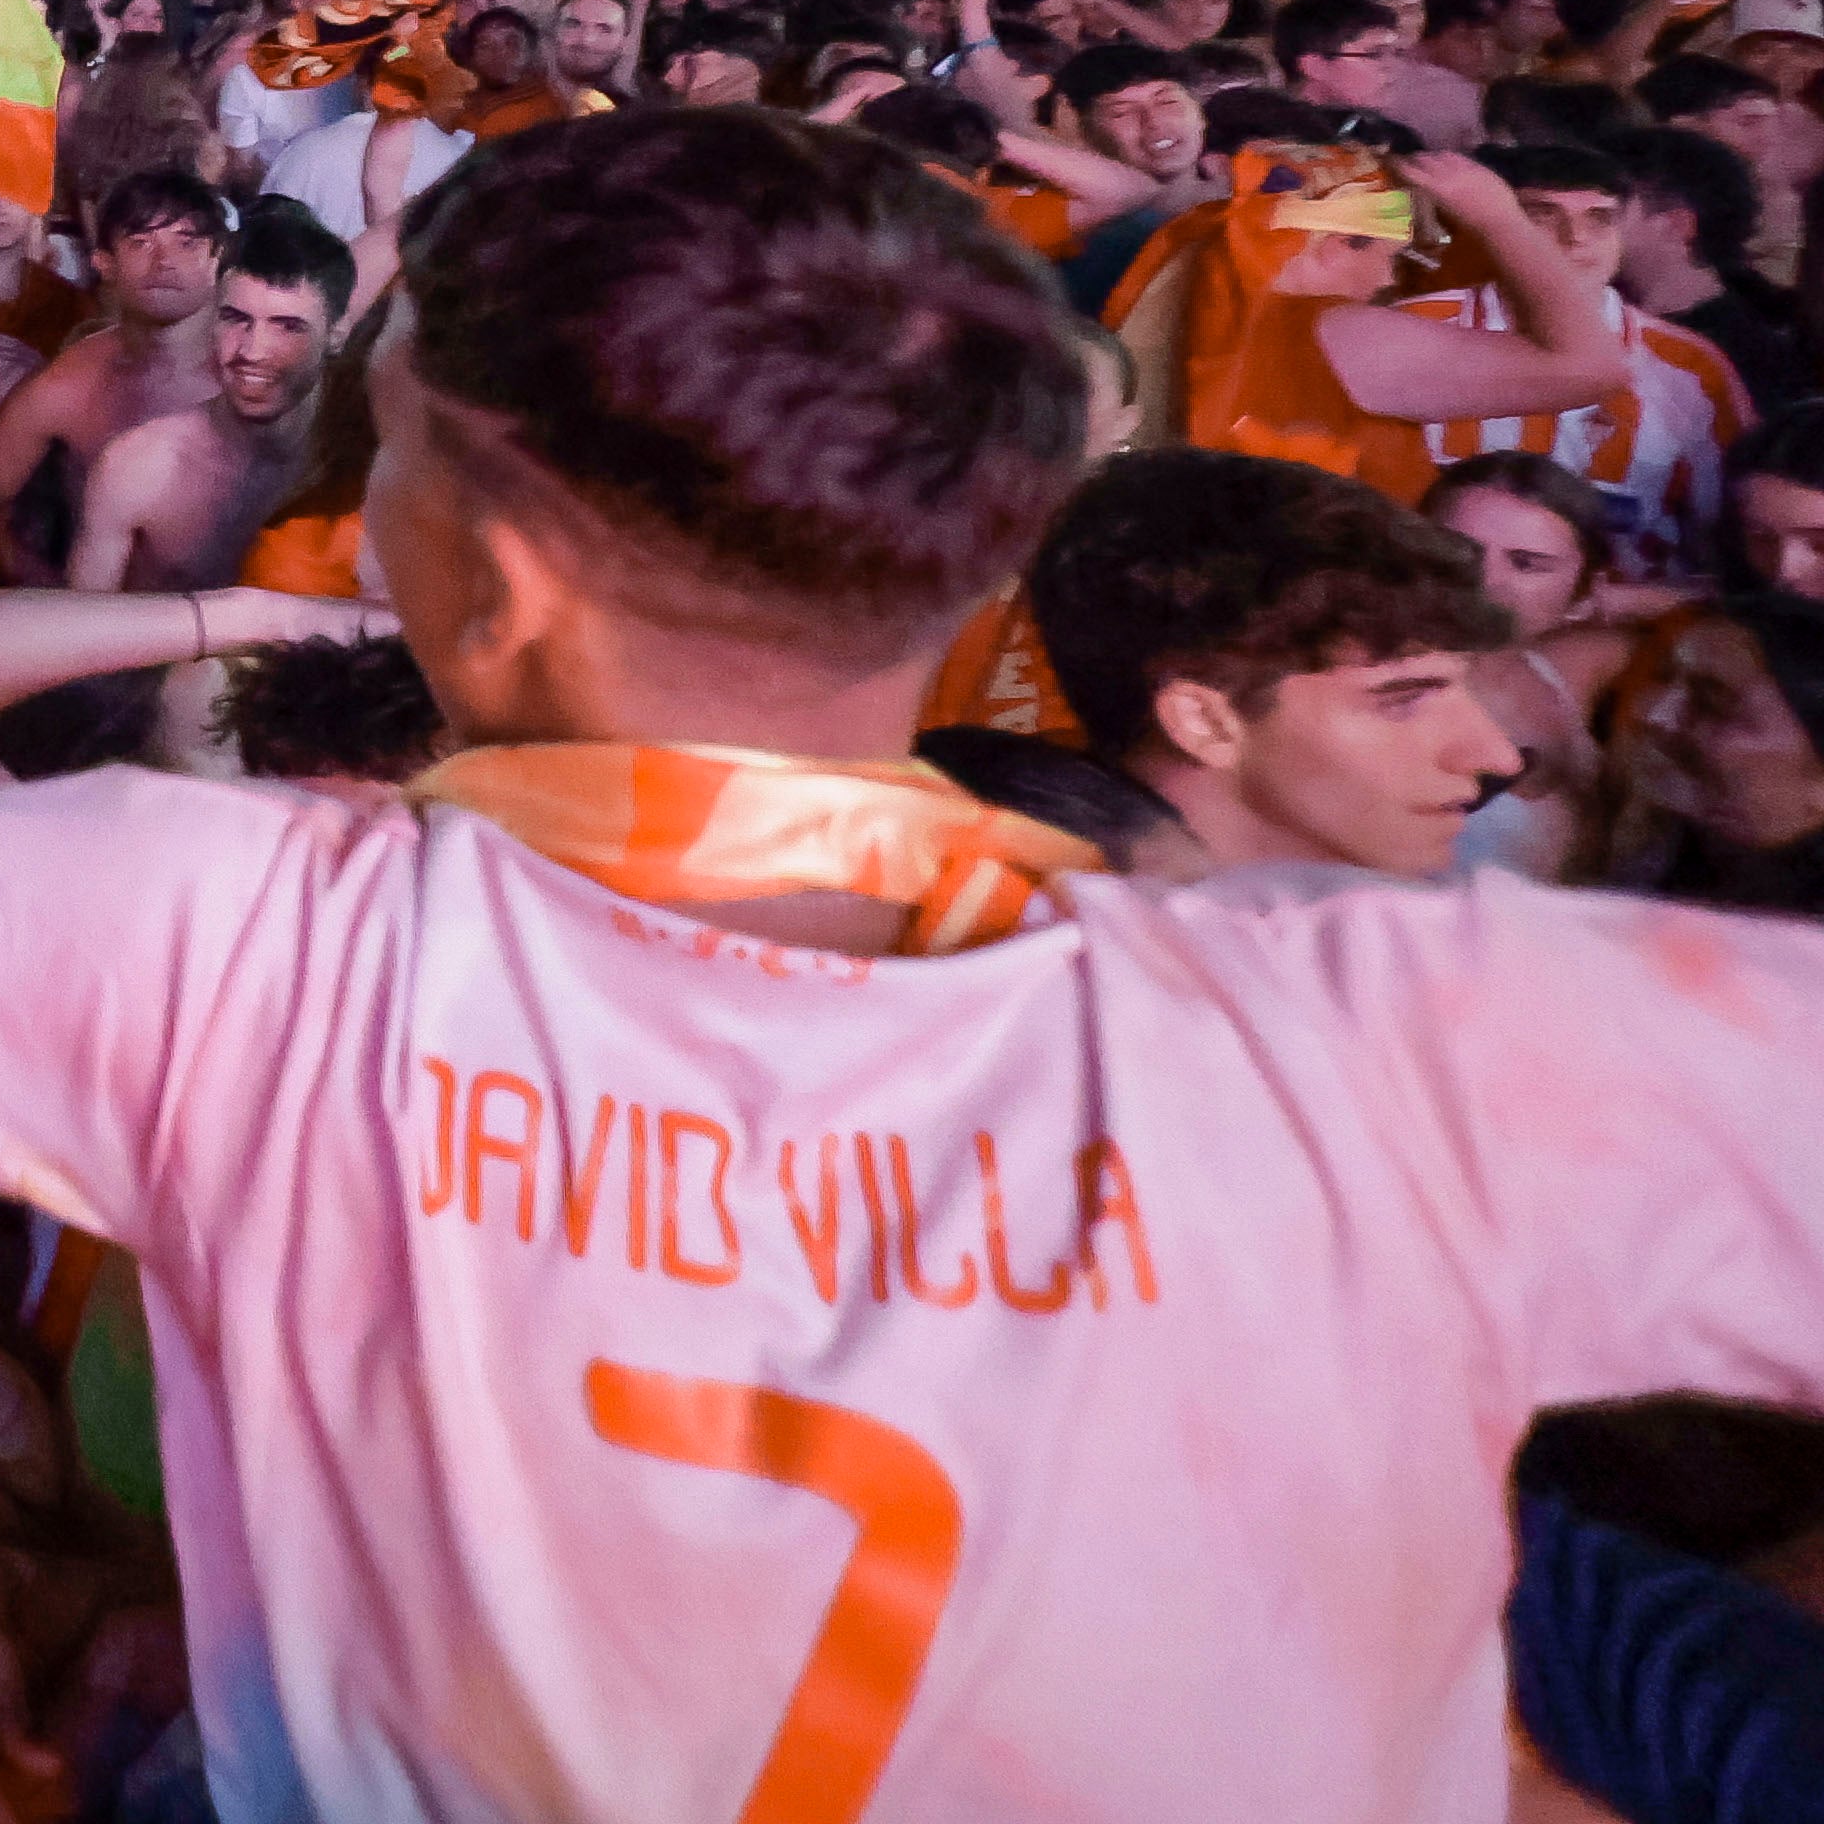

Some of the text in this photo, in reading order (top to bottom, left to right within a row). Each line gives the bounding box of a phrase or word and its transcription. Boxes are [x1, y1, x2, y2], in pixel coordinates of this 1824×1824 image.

[420, 1056, 1160, 1313] DAVID VILLA
[585, 1358, 963, 1824] 7
